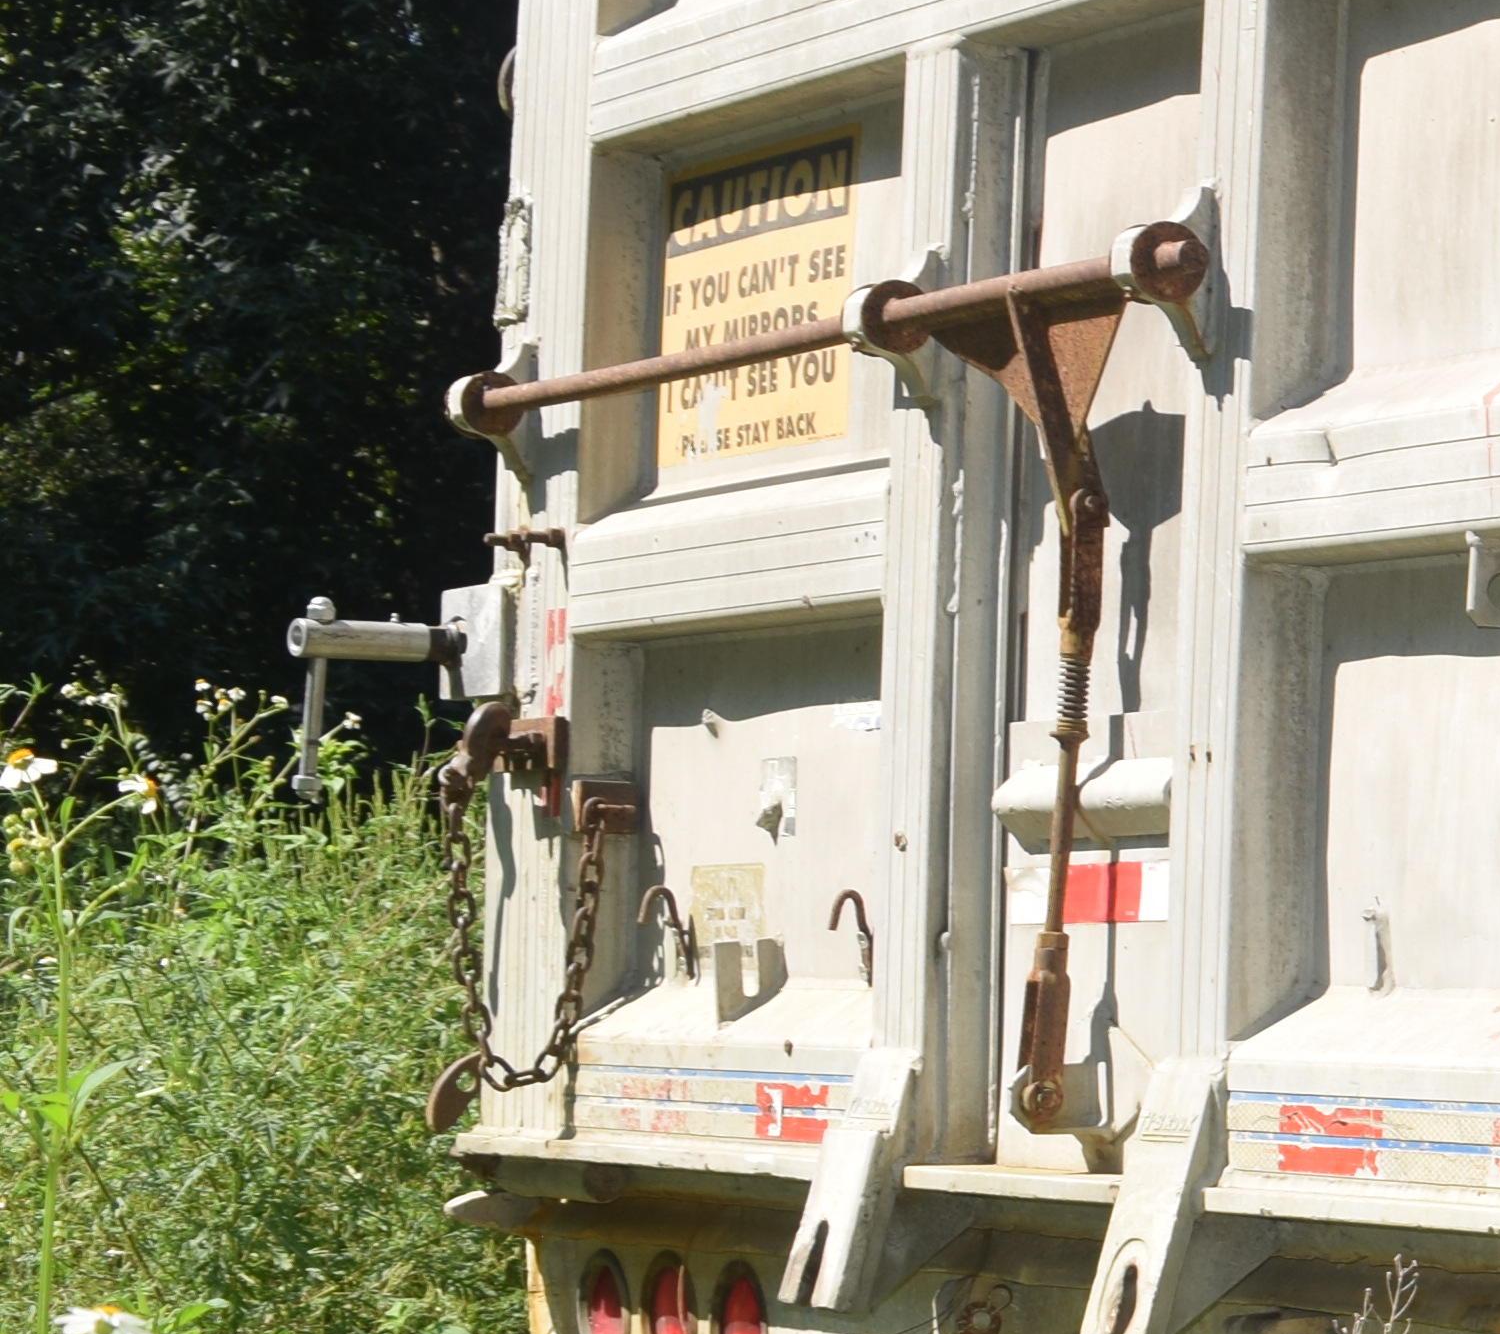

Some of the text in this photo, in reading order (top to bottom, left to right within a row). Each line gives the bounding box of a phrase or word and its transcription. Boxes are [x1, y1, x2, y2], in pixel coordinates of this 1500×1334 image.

[673, 149, 849, 247] CAUTION
[665, 244, 847, 317] IF YOU CAN'T SEE
[747, 359, 778, 398] SEE
[788, 349, 836, 389] YOU
[736, 419, 770, 448] STAY
[776, 411, 817, 440] BACK
